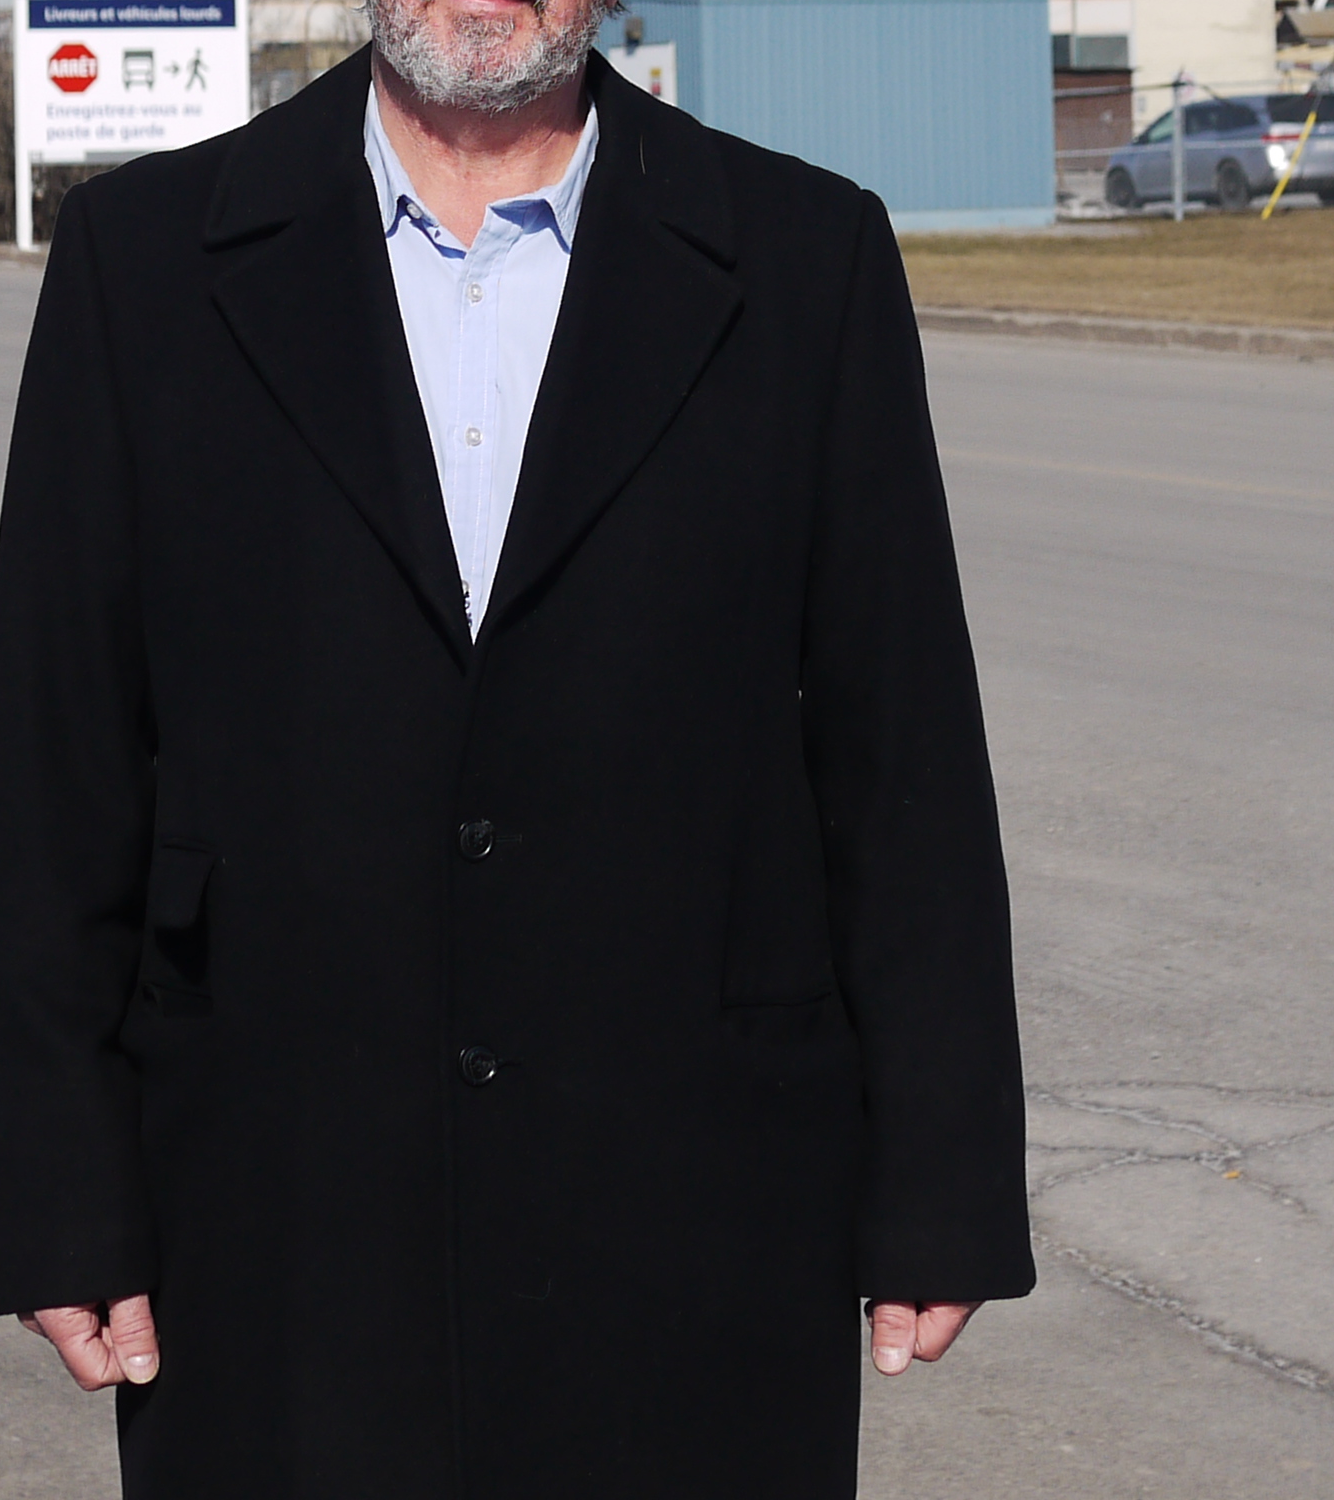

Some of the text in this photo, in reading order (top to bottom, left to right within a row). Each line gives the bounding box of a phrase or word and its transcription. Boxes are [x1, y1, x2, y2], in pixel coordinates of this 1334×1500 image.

[44, 5, 222, 22] Livreurs et véhicules lourds
[49, 55, 97, 78] ARRÊT
[46, 104, 202, 120] Enregistrez-vous au
[46, 124, 165, 143] poste de garde
